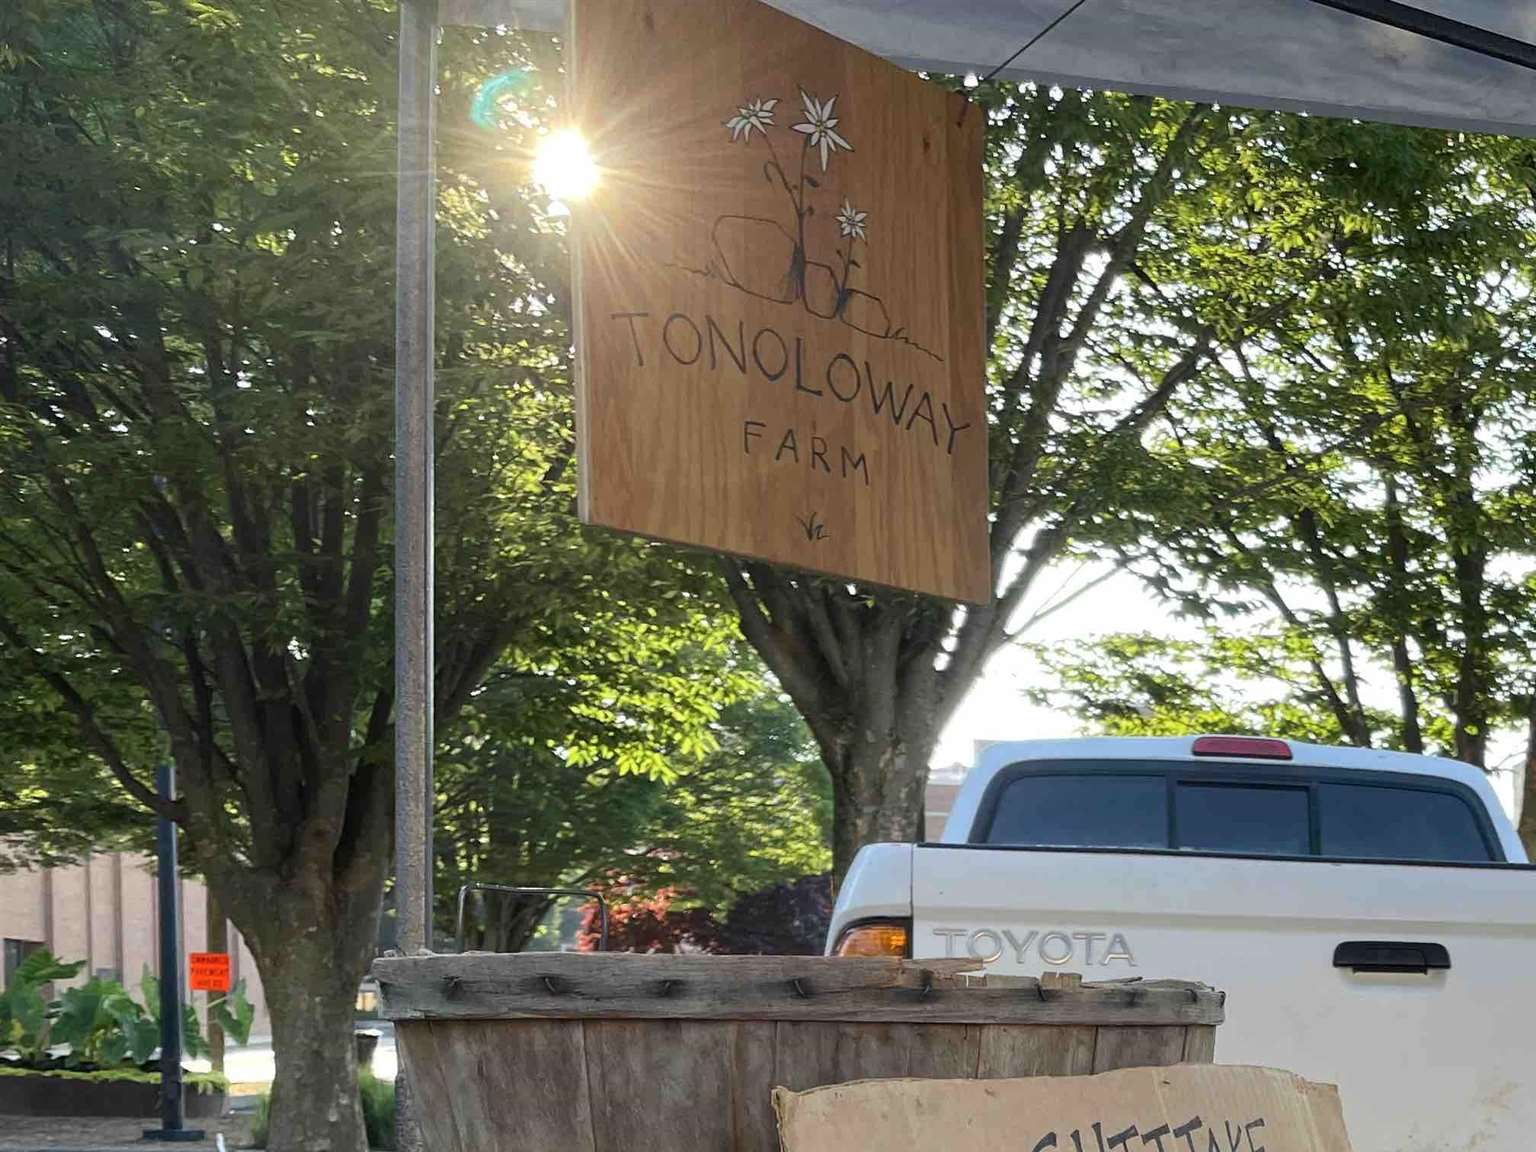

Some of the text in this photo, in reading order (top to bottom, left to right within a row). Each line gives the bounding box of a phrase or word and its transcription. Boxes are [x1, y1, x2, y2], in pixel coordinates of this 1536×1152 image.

[611, 312, 970, 455] TONOLOWAY
[742, 420, 870, 485] FARM
[932, 928, 1138, 967] TOYOTA
